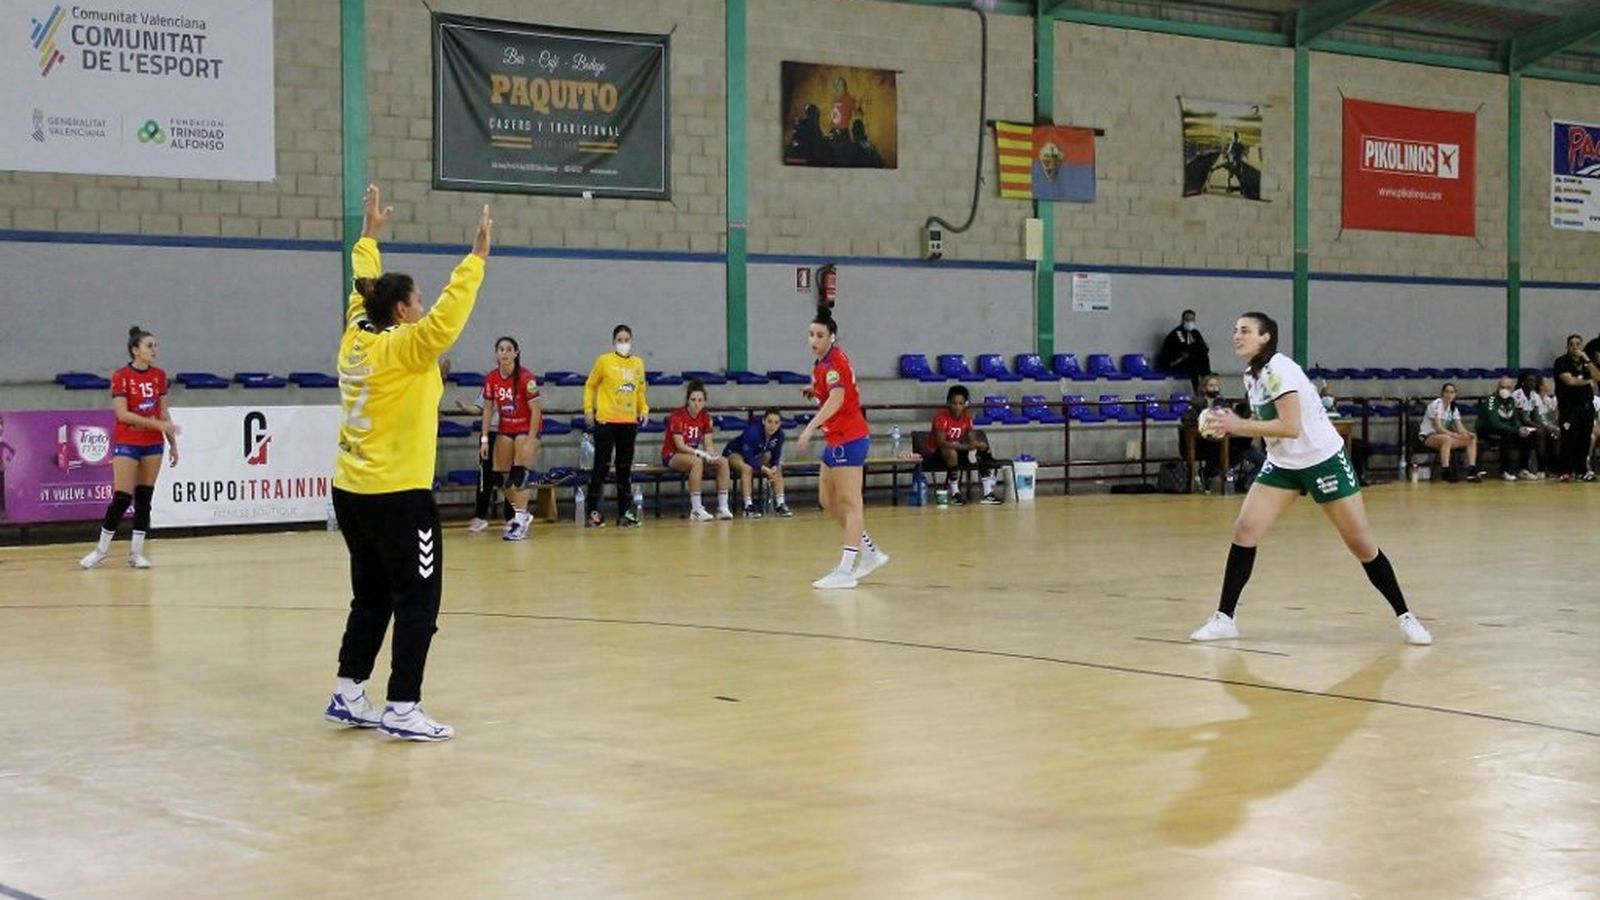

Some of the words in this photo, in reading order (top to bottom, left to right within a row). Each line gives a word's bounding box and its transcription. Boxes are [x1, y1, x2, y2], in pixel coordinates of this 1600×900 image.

[72, 6, 137, 25] Comunitat
[140, 13, 206, 30] Valenciana
[71, 25, 206, 54] COMUNITAT
[83, 50, 112, 71] DE
[119, 53, 222, 79] L'ESPORT
[490, 74, 618, 115] PAQUITO
[47, 116, 106, 128] GENERALITAT
[489, 118, 532, 131] CASERO
[537, 121, 543, 132] Y
[551, 122, 620, 137] TRADICIONAL
[49, 127, 105, 137] VALENCIANA
[170, 127, 224, 140] TRINIDAD
[170, 139, 224, 151] ALFONSO
[1365, 140, 1435, 173] PIKOLINOS
[139, 382, 154, 398] 15
[498, 387, 513, 401] 94
[80, 429, 109, 443] Tripto
[688, 426, 699, 438] 31
[950, 427, 962, 438] 77
[54, 487, 85, 500] VUELVE
[87, 488, 93, 498] A
[95, 484, 113, 500] SER
